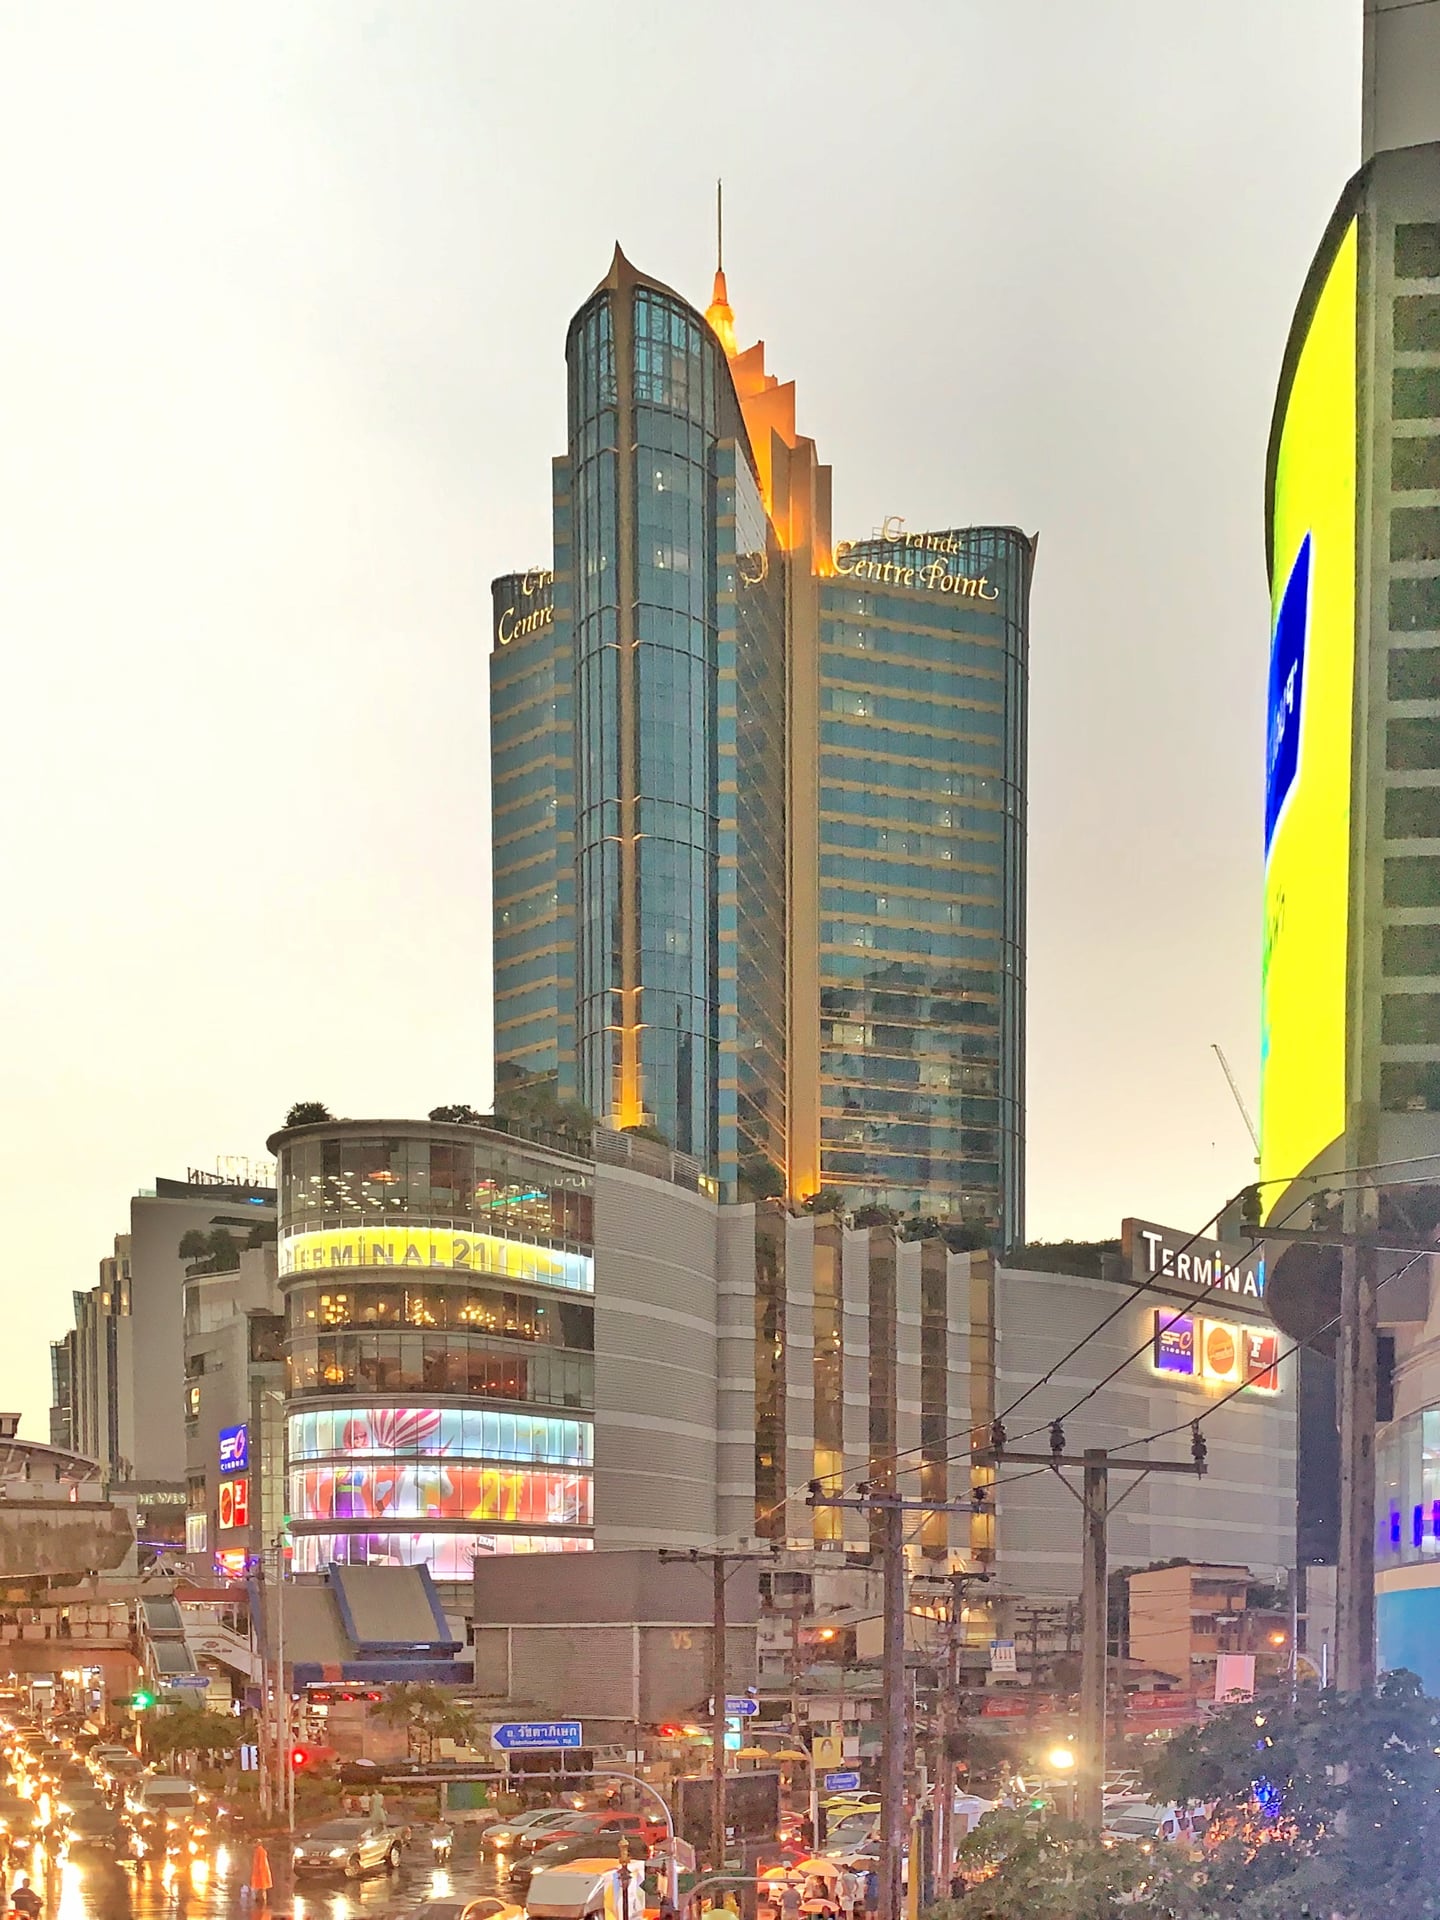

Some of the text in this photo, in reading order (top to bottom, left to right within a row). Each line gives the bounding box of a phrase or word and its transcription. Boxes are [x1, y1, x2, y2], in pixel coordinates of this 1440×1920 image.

[832, 540, 999, 600] Centre Point
[452, 1238, 486, 1271] 21
